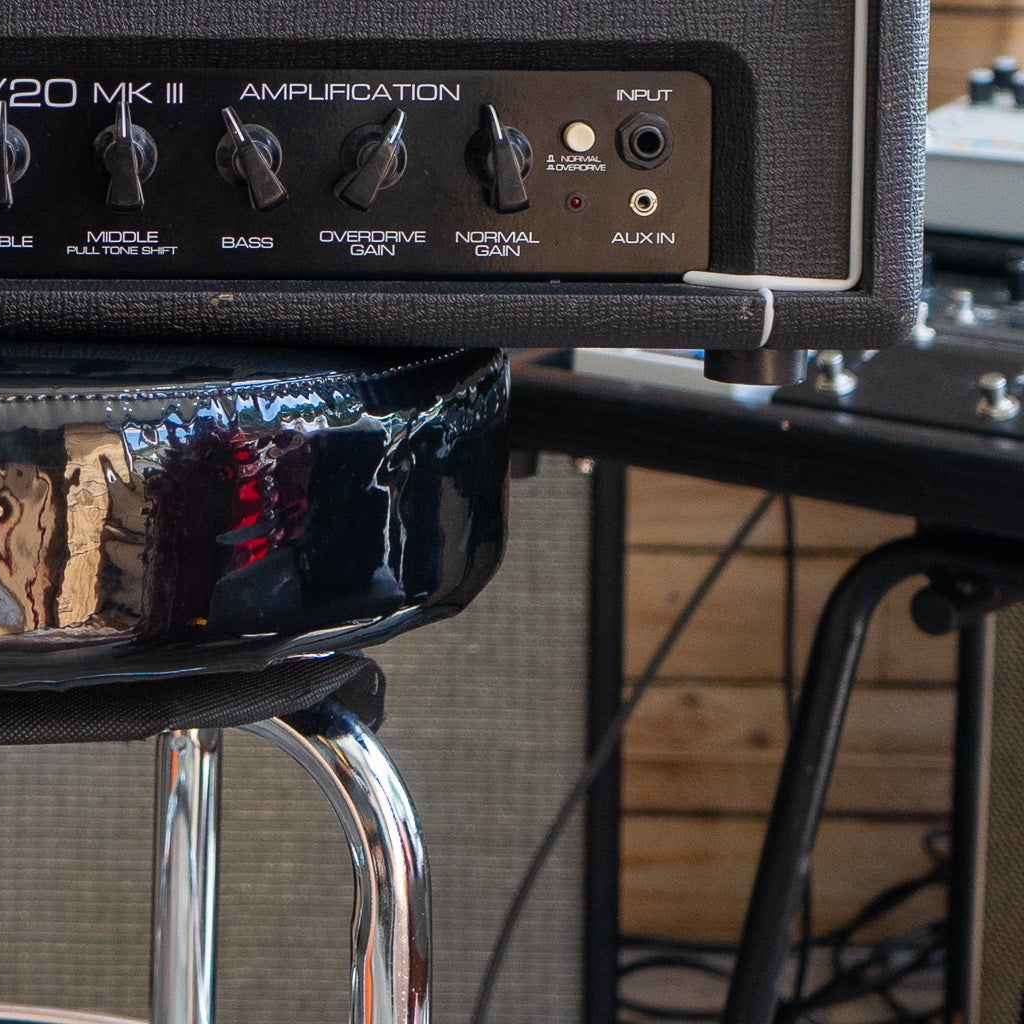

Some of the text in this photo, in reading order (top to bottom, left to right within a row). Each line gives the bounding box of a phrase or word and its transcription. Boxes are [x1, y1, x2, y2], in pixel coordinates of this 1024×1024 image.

[93, 82, 153, 104] MK
[166, 82, 183, 104] III
[239, 83, 460, 101] AMPLIFICATION
[616, 89, 673, 102] INPUT
[560, 155, 602, 163] NORMAL
[555, 163, 607, 172] OVERDRIVE
[87, 230, 159, 244] MIDDLE
[221, 236, 274, 249] BASS
[319, 230, 427, 243] OVERDRIVE
[455, 231, 540, 244] NORMAL
[611, 231, 676, 244] AUX IN
[66, 245, 178, 255] PULL TONE SHIFT
[350, 243, 396, 256] GAIN
[474, 244, 521, 257] GAIN
